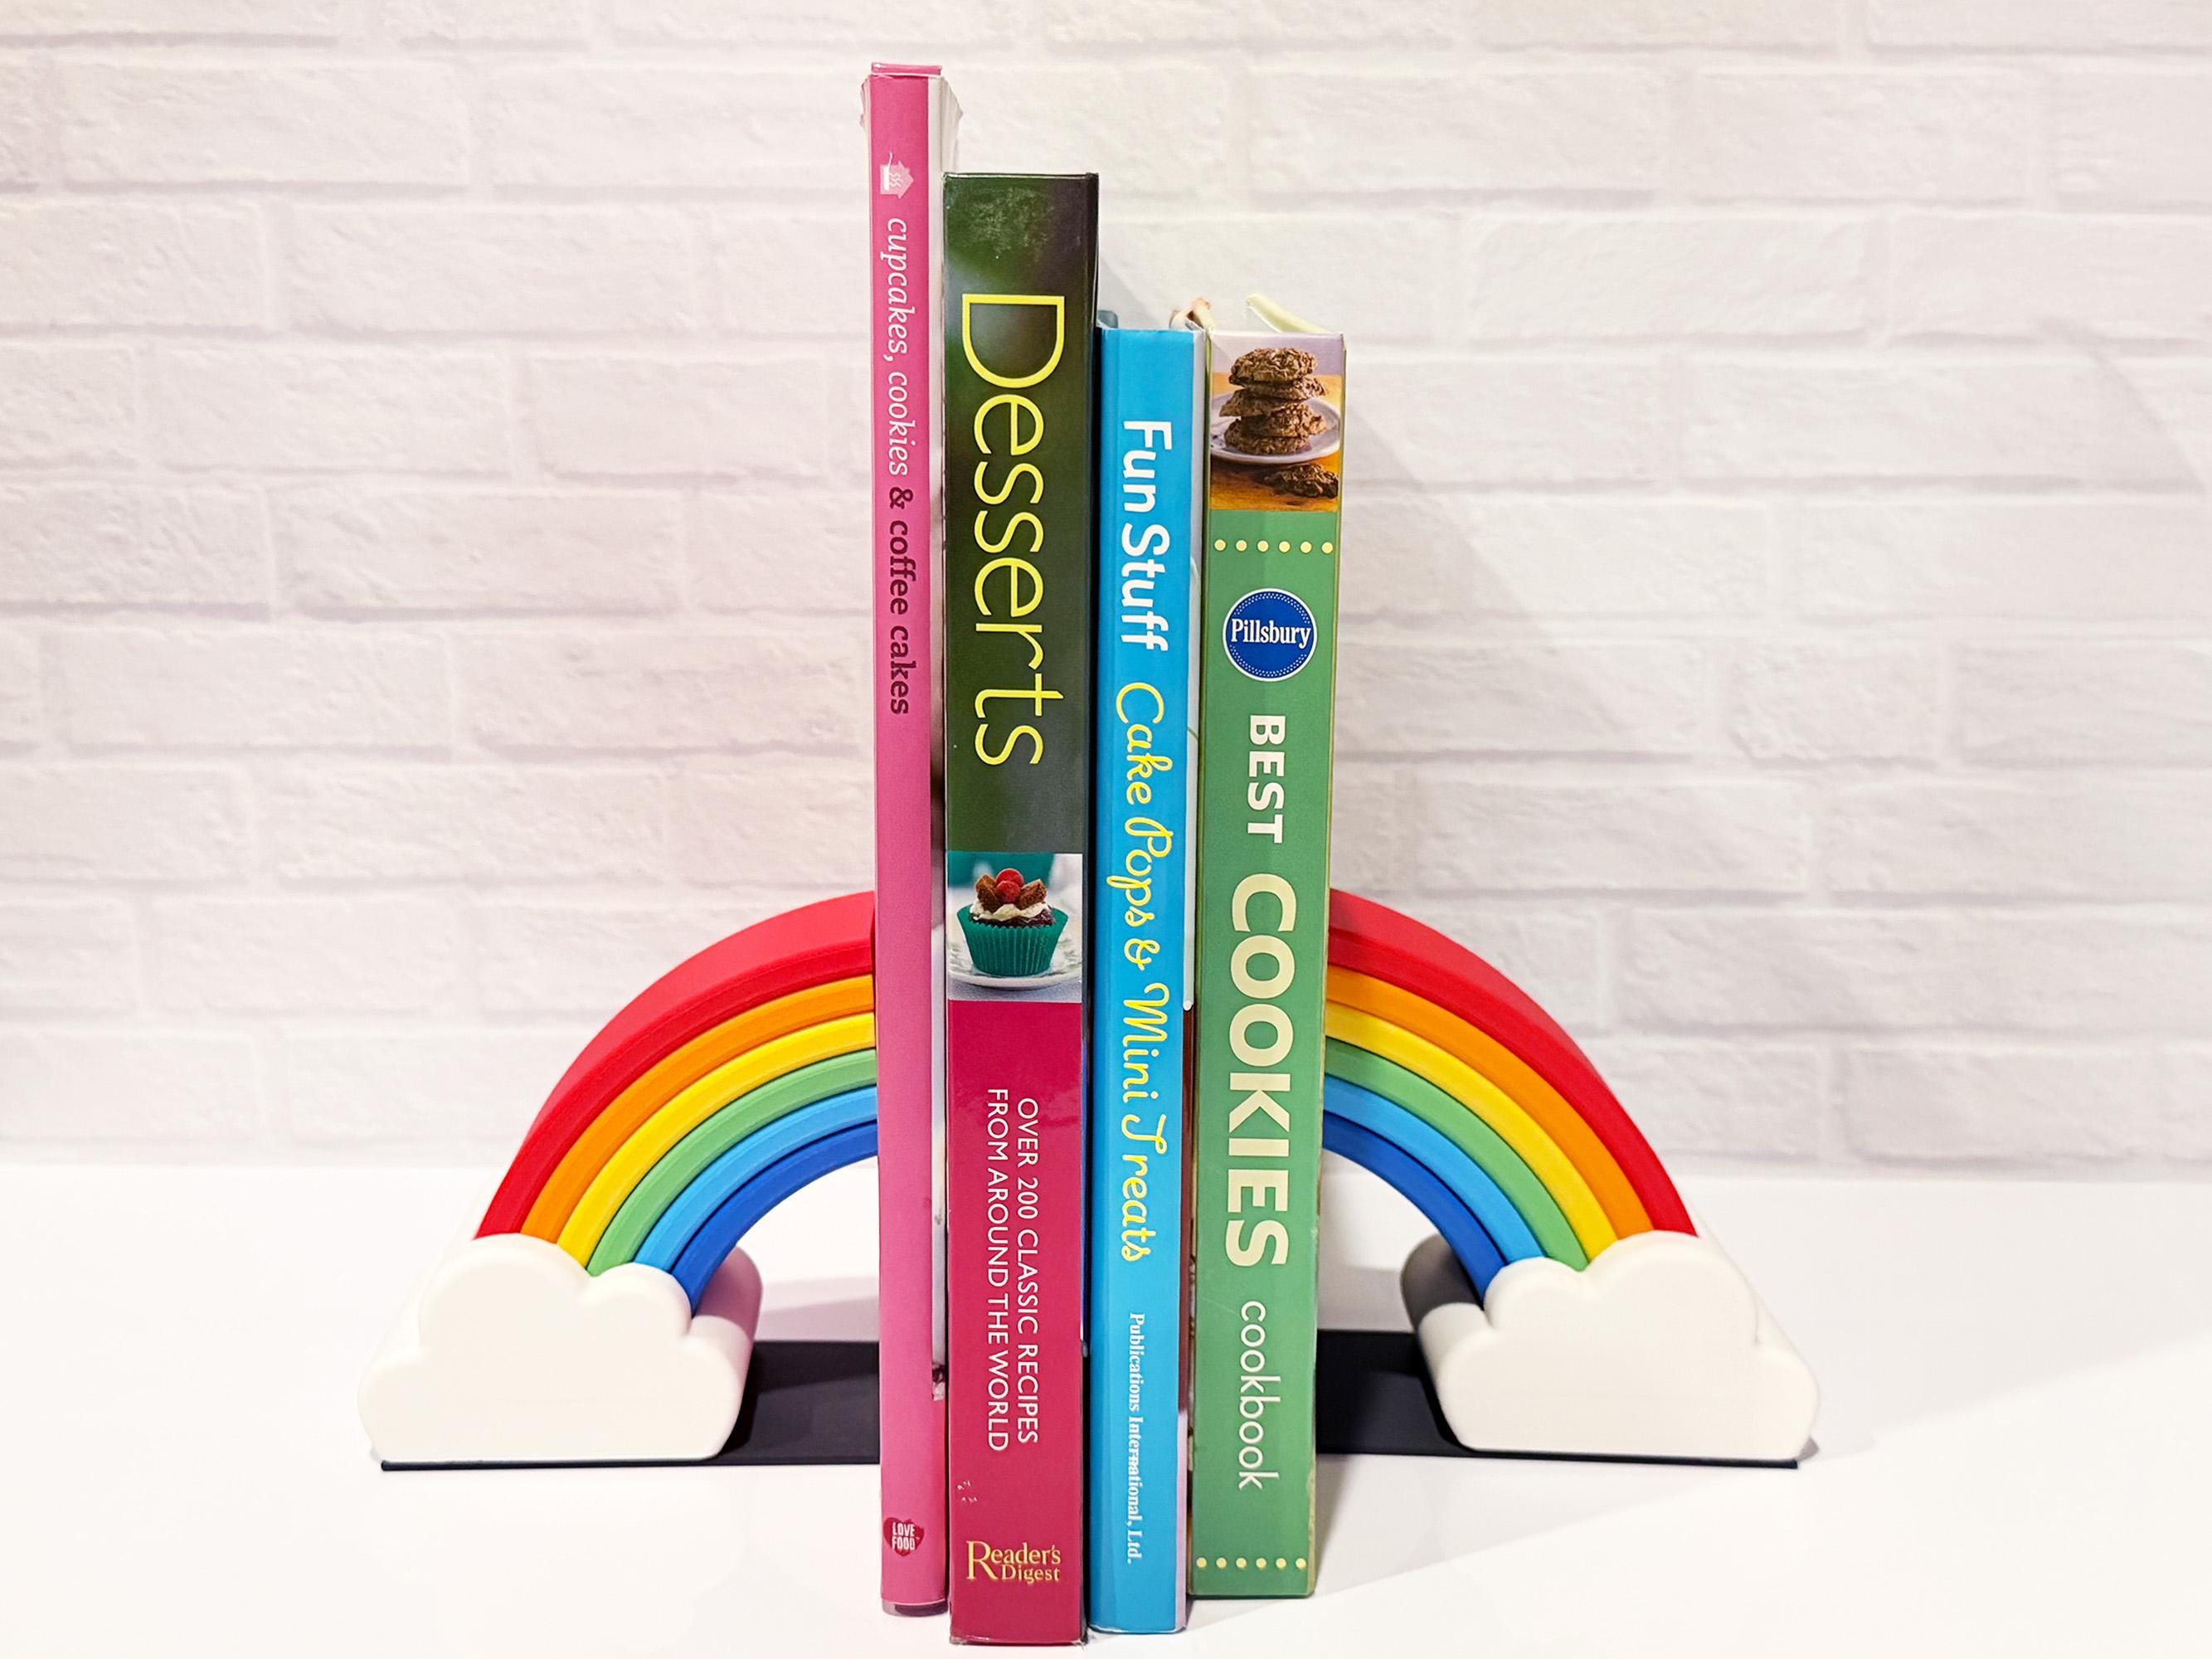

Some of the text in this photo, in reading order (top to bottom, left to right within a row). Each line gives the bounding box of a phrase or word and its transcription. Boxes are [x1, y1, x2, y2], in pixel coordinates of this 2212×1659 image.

[880, 217, 917, 715] cupcakes, cookies & coffee cakes
[960, 293, 1066, 766] Desserts
[1120, 421, 1172, 651] Fun Stuff
[1231, 618, 1311, 649] Pillsbury
[1247, 715, 1286, 844] BEST
[1106, 682, 1172, 1262] Cake Pops & Mini Treats
[1225, 873, 1296, 1267] COOKIES
[987, 1089, 1010, 1452] FROM AROUND THE WORLD
[1016, 1097, 1039, 1444] OVER 200 CLASSIC RECIPES
[1127, 1313, 1145, 1564] Publications International, Ltd.
[1238, 1301, 1281, 1490] cookbook
[891, 1535, 916, 1551] FOOD
[892, 1522, 916, 1537] LOVE
[966, 1540, 1062, 1581] Reader's
[1000, 1564, 1061, 1585] Digest
